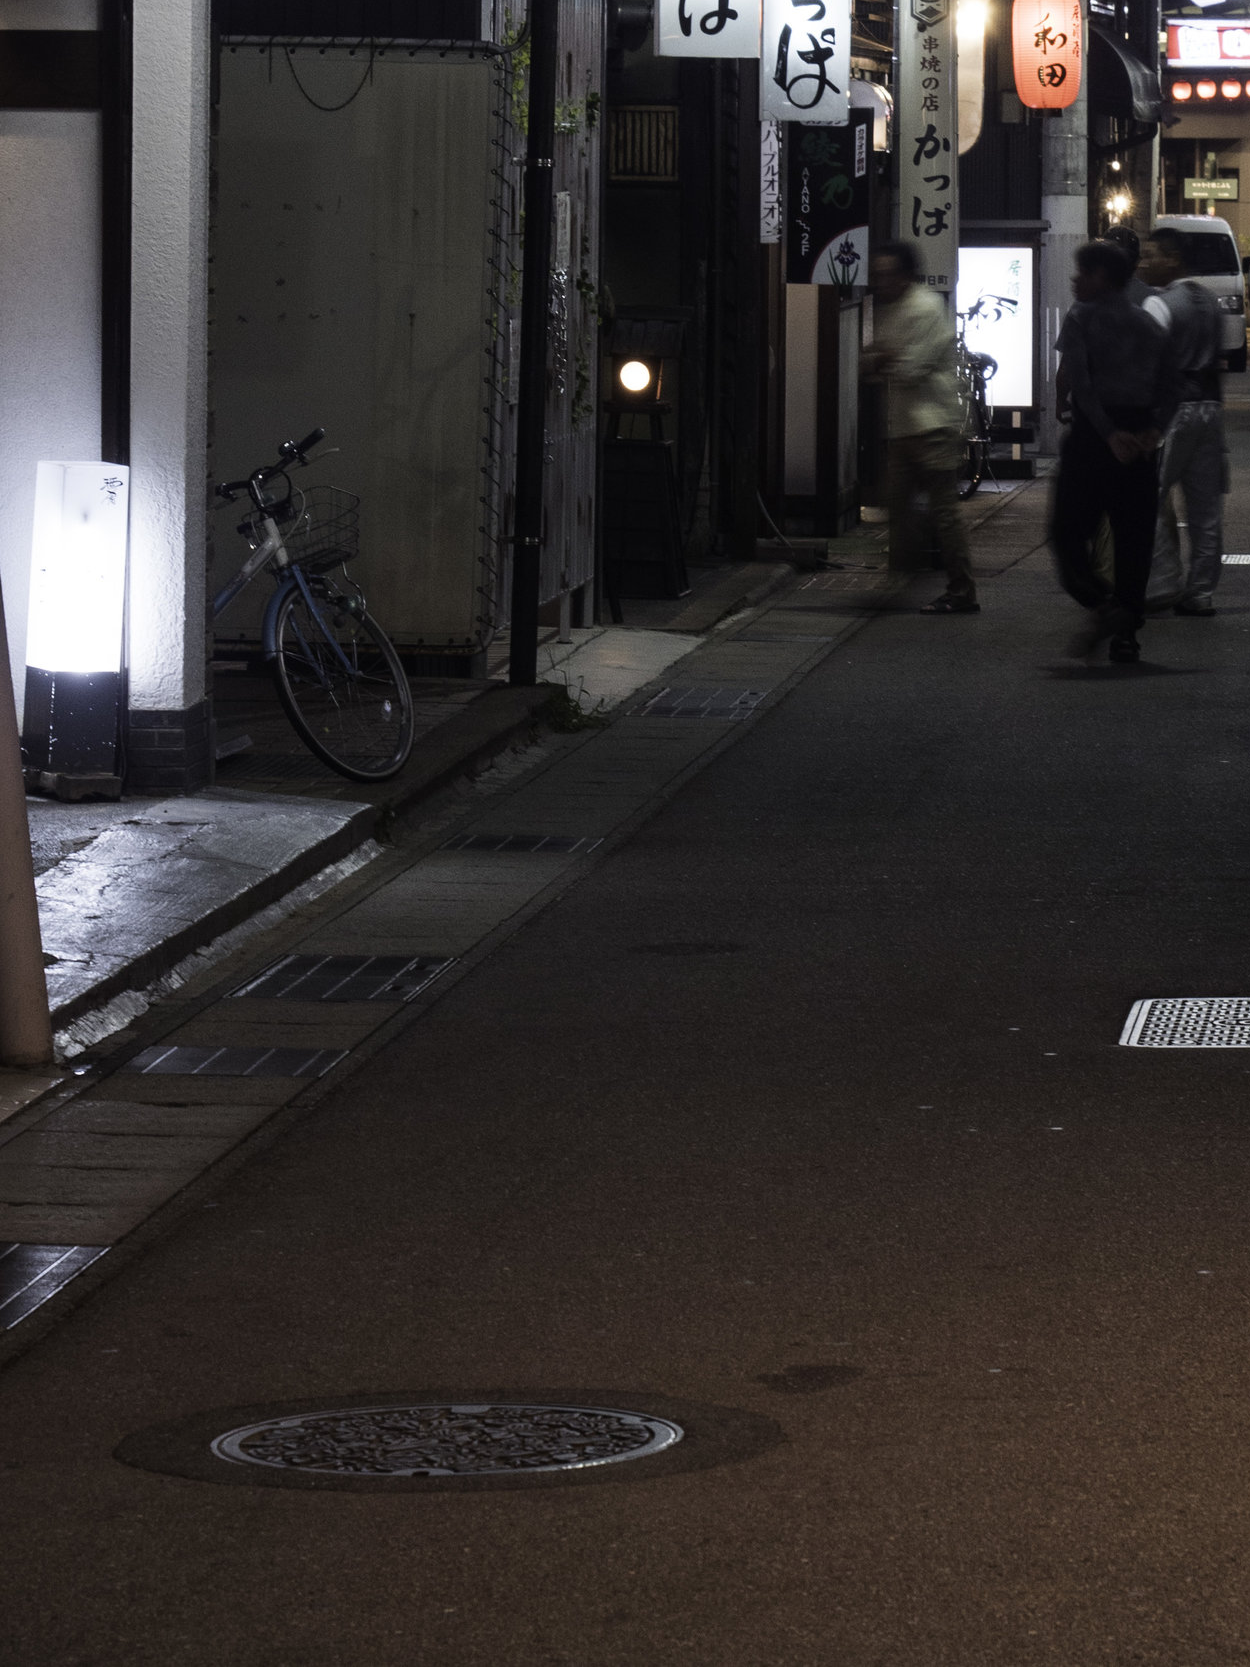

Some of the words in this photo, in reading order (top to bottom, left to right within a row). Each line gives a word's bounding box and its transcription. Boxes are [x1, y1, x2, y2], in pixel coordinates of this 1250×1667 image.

[920, 36, 941, 111] 串焼の店
[1034, 12, 1068, 88] 和田
[801, 167, 810, 214] AYANO
[912, 124, 951, 237] かっぱ
[801, 233, 810, 256] 2F
